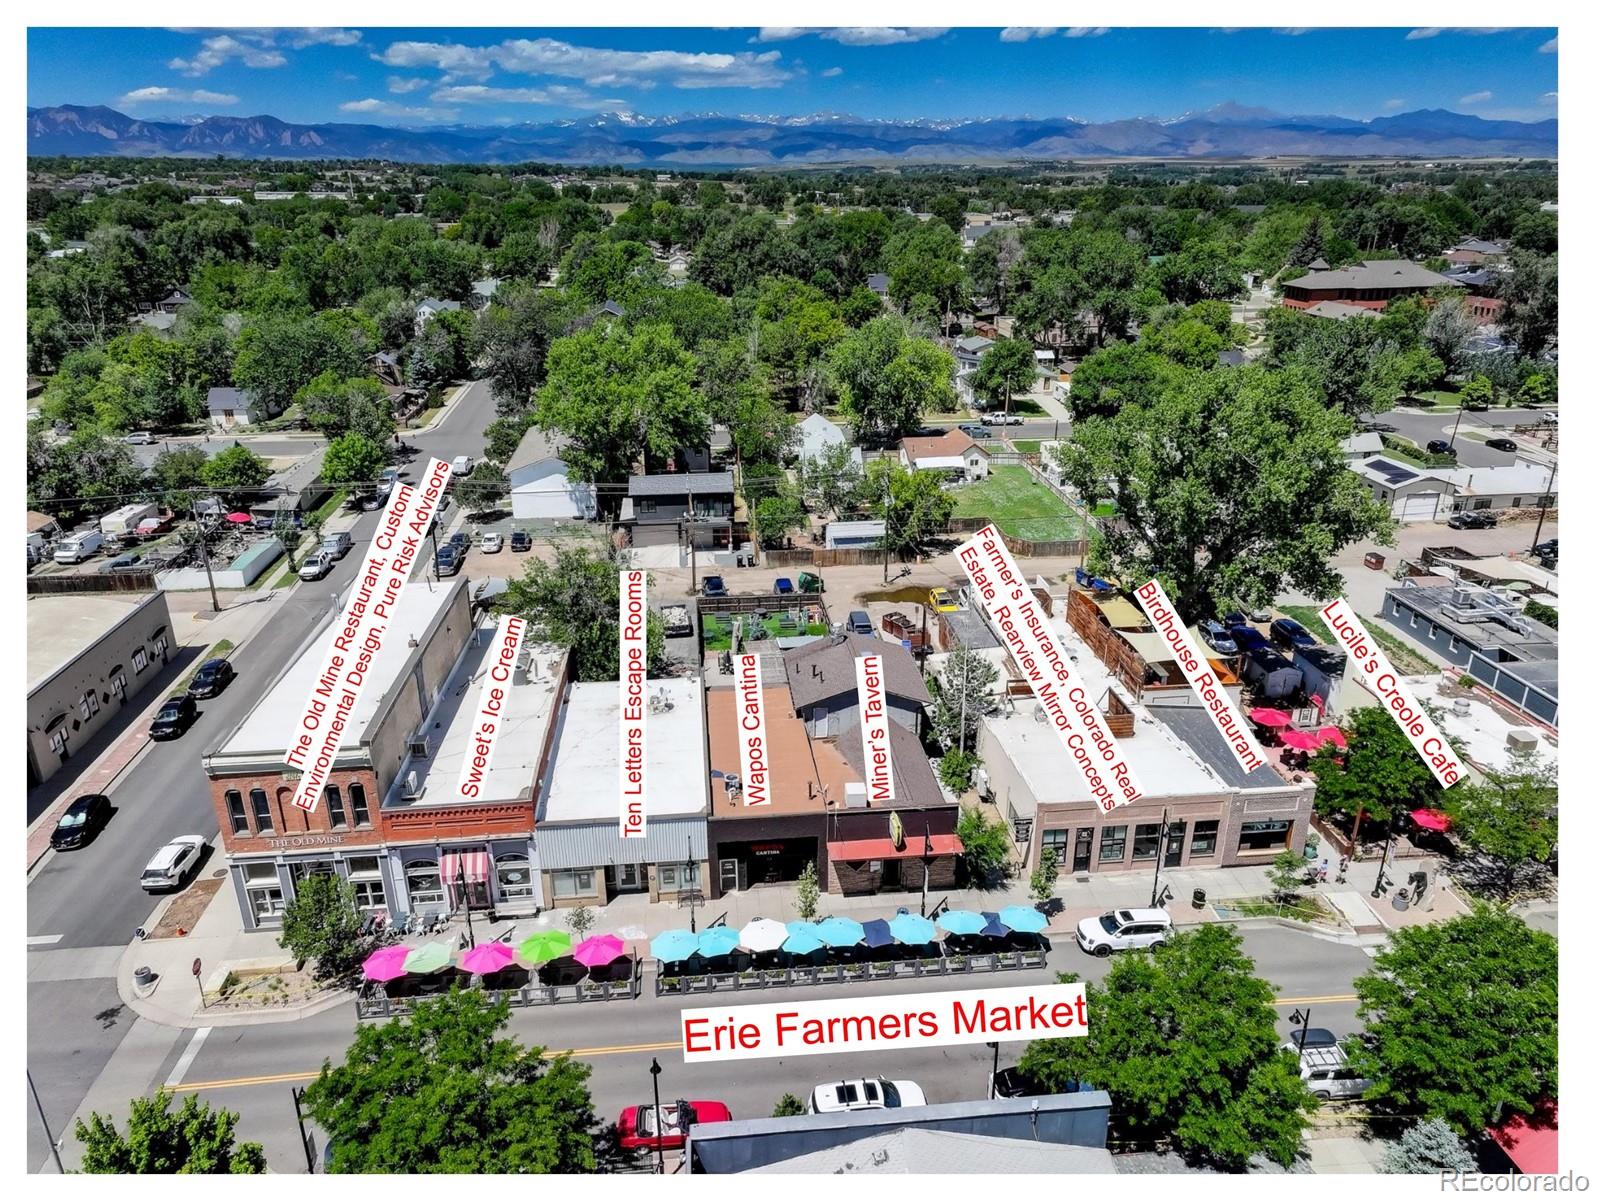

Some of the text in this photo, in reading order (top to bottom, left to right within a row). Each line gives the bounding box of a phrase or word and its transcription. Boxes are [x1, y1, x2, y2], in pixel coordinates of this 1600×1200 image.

[270, 835, 345, 848] THE OLD MINE
